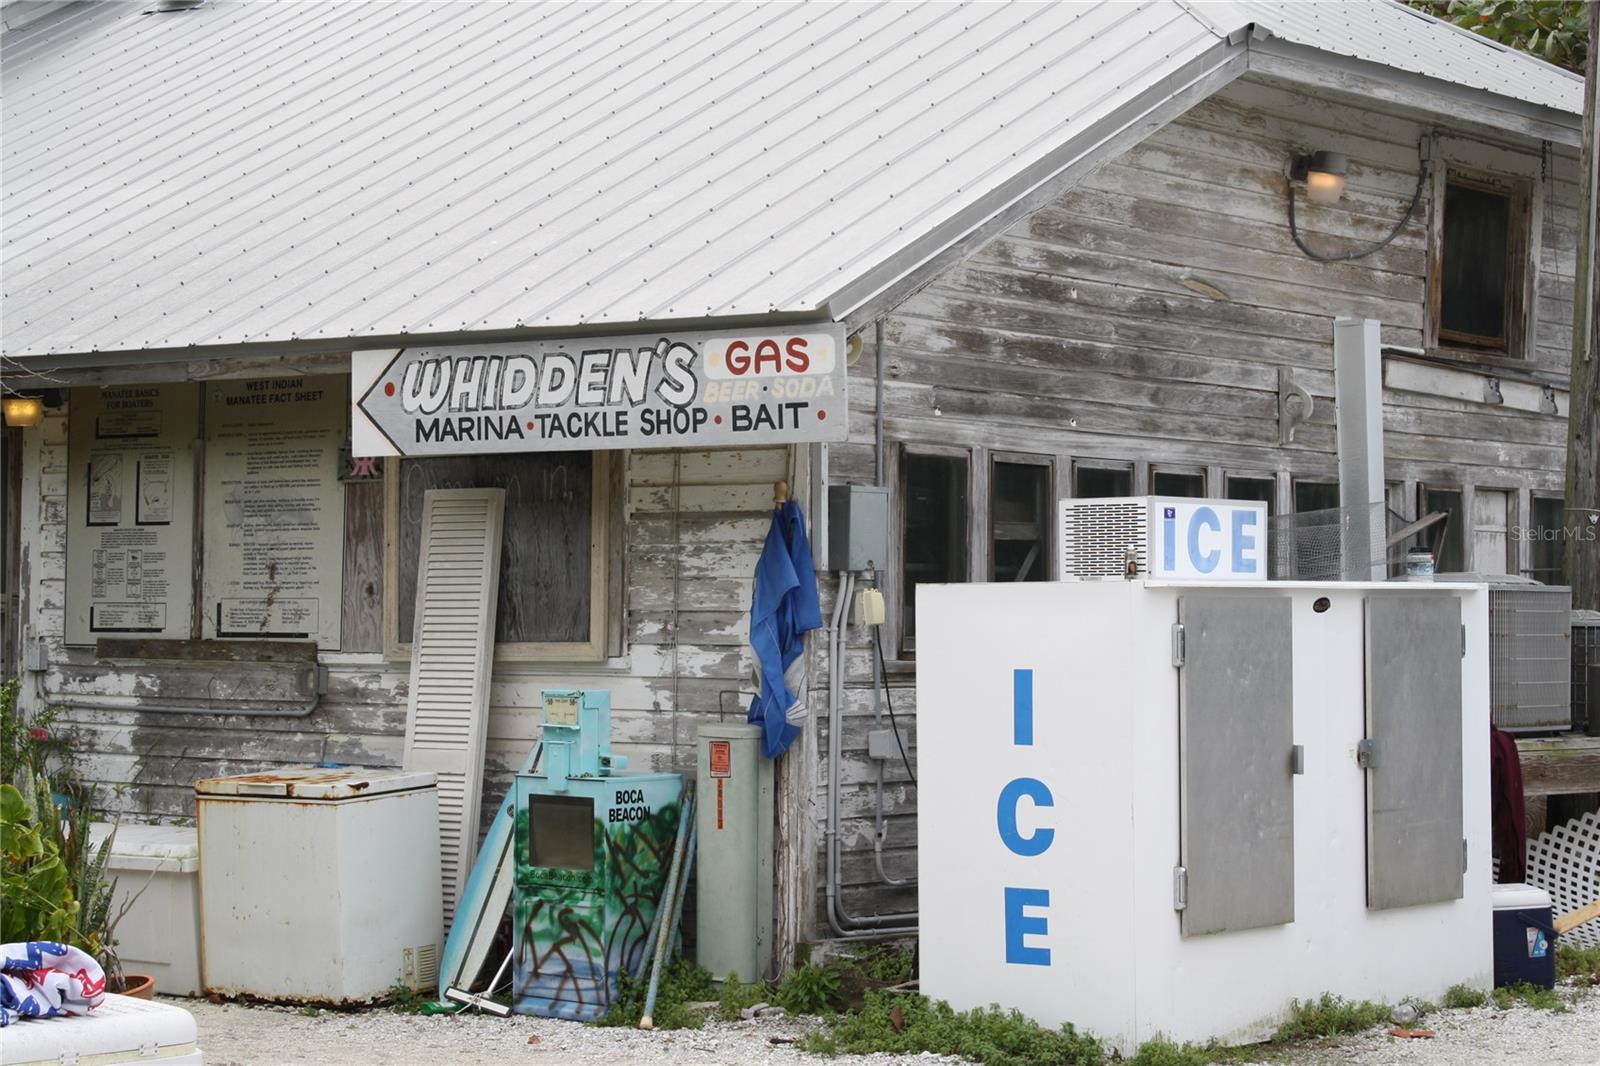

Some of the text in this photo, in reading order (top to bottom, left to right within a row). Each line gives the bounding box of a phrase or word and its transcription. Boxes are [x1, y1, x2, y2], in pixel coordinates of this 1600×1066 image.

[725, 337, 810, 376] GAS
[246, 378, 303, 391] WEST INDIAN
[401, 337, 698, 414] WHIDDEN'S
[703, 375, 835, 403] BEER SODA
[226, 390, 324, 406] MANATEE FACT SHEET
[416, 402, 809, 443] MARINA TACKLE SHOP BAIT
[608, 789, 651, 823] BOCA BEACON
[997, 668, 1056, 967] ICE
